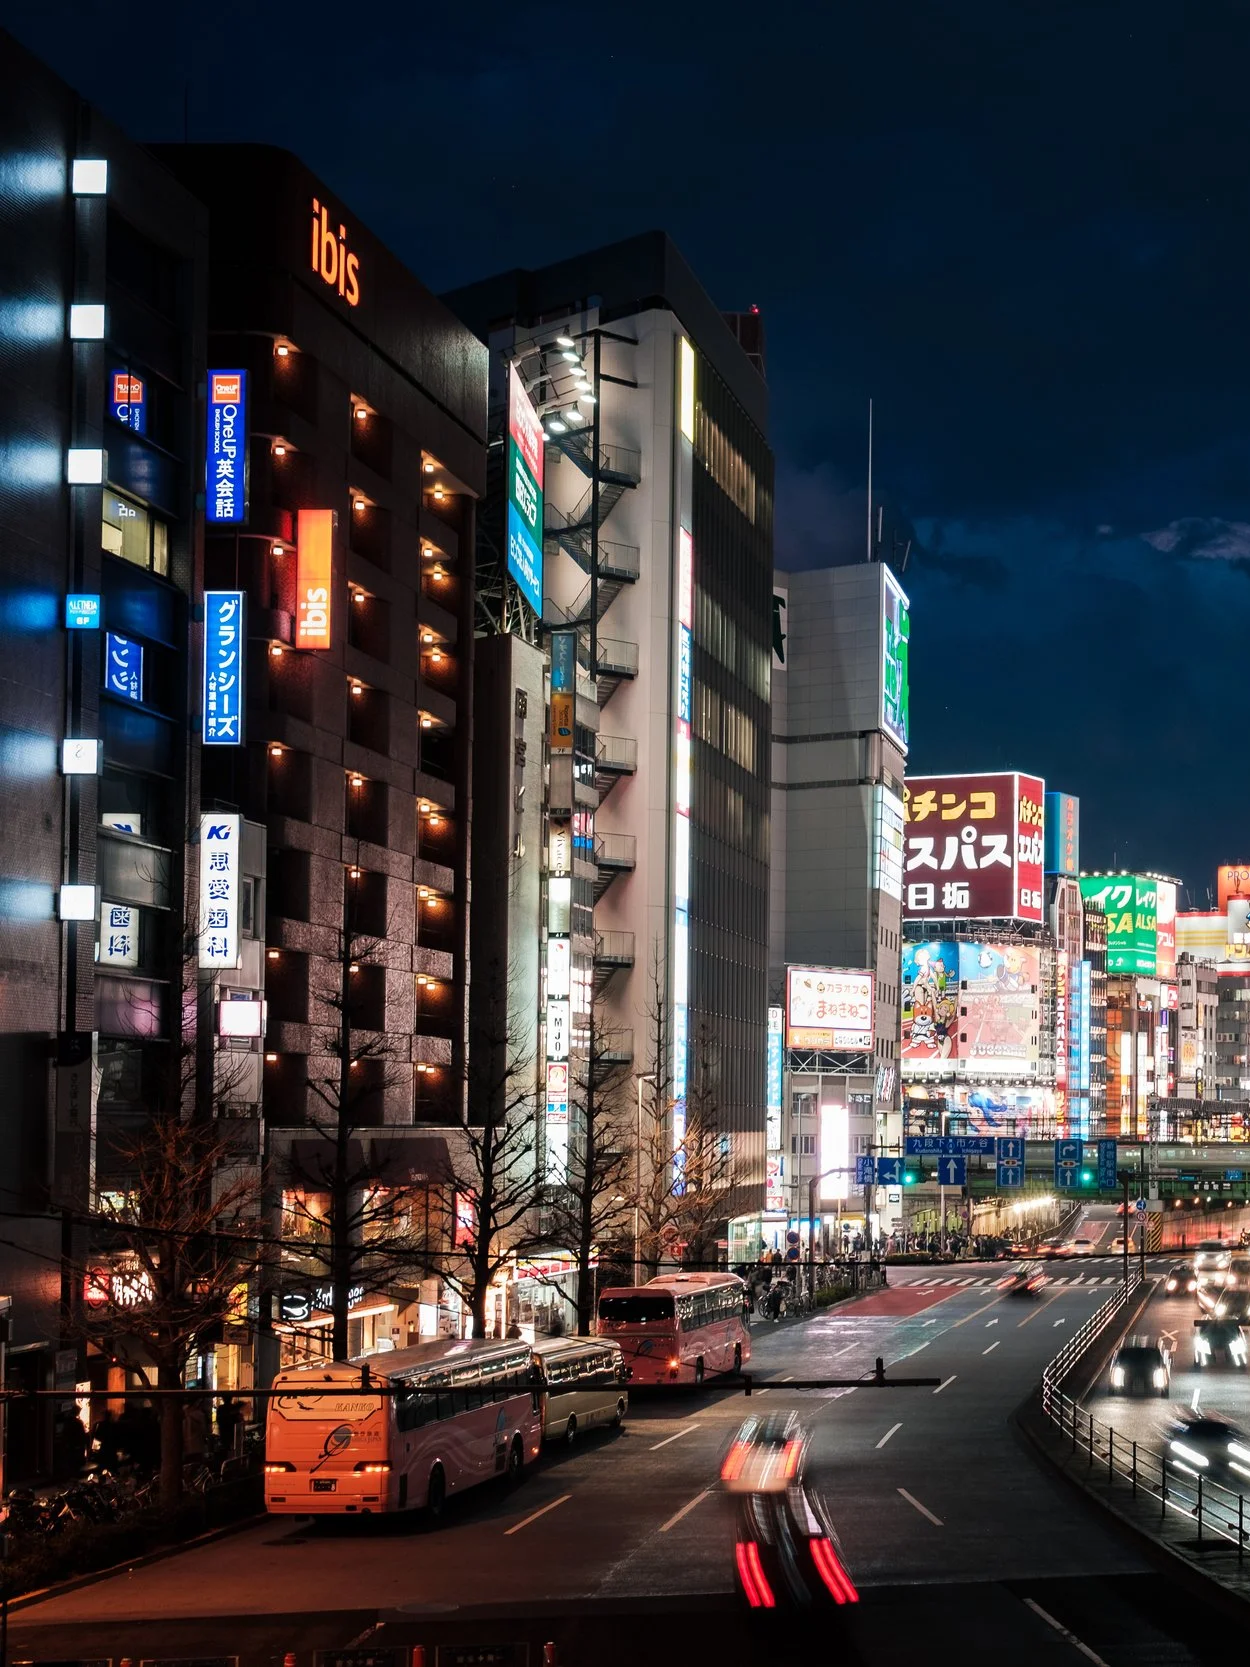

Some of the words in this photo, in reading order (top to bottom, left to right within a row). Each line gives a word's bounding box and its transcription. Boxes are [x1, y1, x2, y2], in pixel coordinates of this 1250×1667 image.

[312, 198, 360, 306] ibis
[222, 404, 238, 458] OneUP
[215, 459, 235, 518] 英会話
[300, 587, 328, 636] ibis
[217, 599, 239, 737] グランシーズ
[1019, 795, 1043, 829] パチンコ
[908, 881, 970, 910] 日拓
[1136, 888, 1157, 908] レイク
[1135, 912, 1157, 932] ALSA
[1157, 930, 1175, 947] アコム
[816, 1000, 868, 1020] まねきねこ
[912, 1138, 946, 1148] 九段下
[335, 1403, 375, 1412] KANKO
